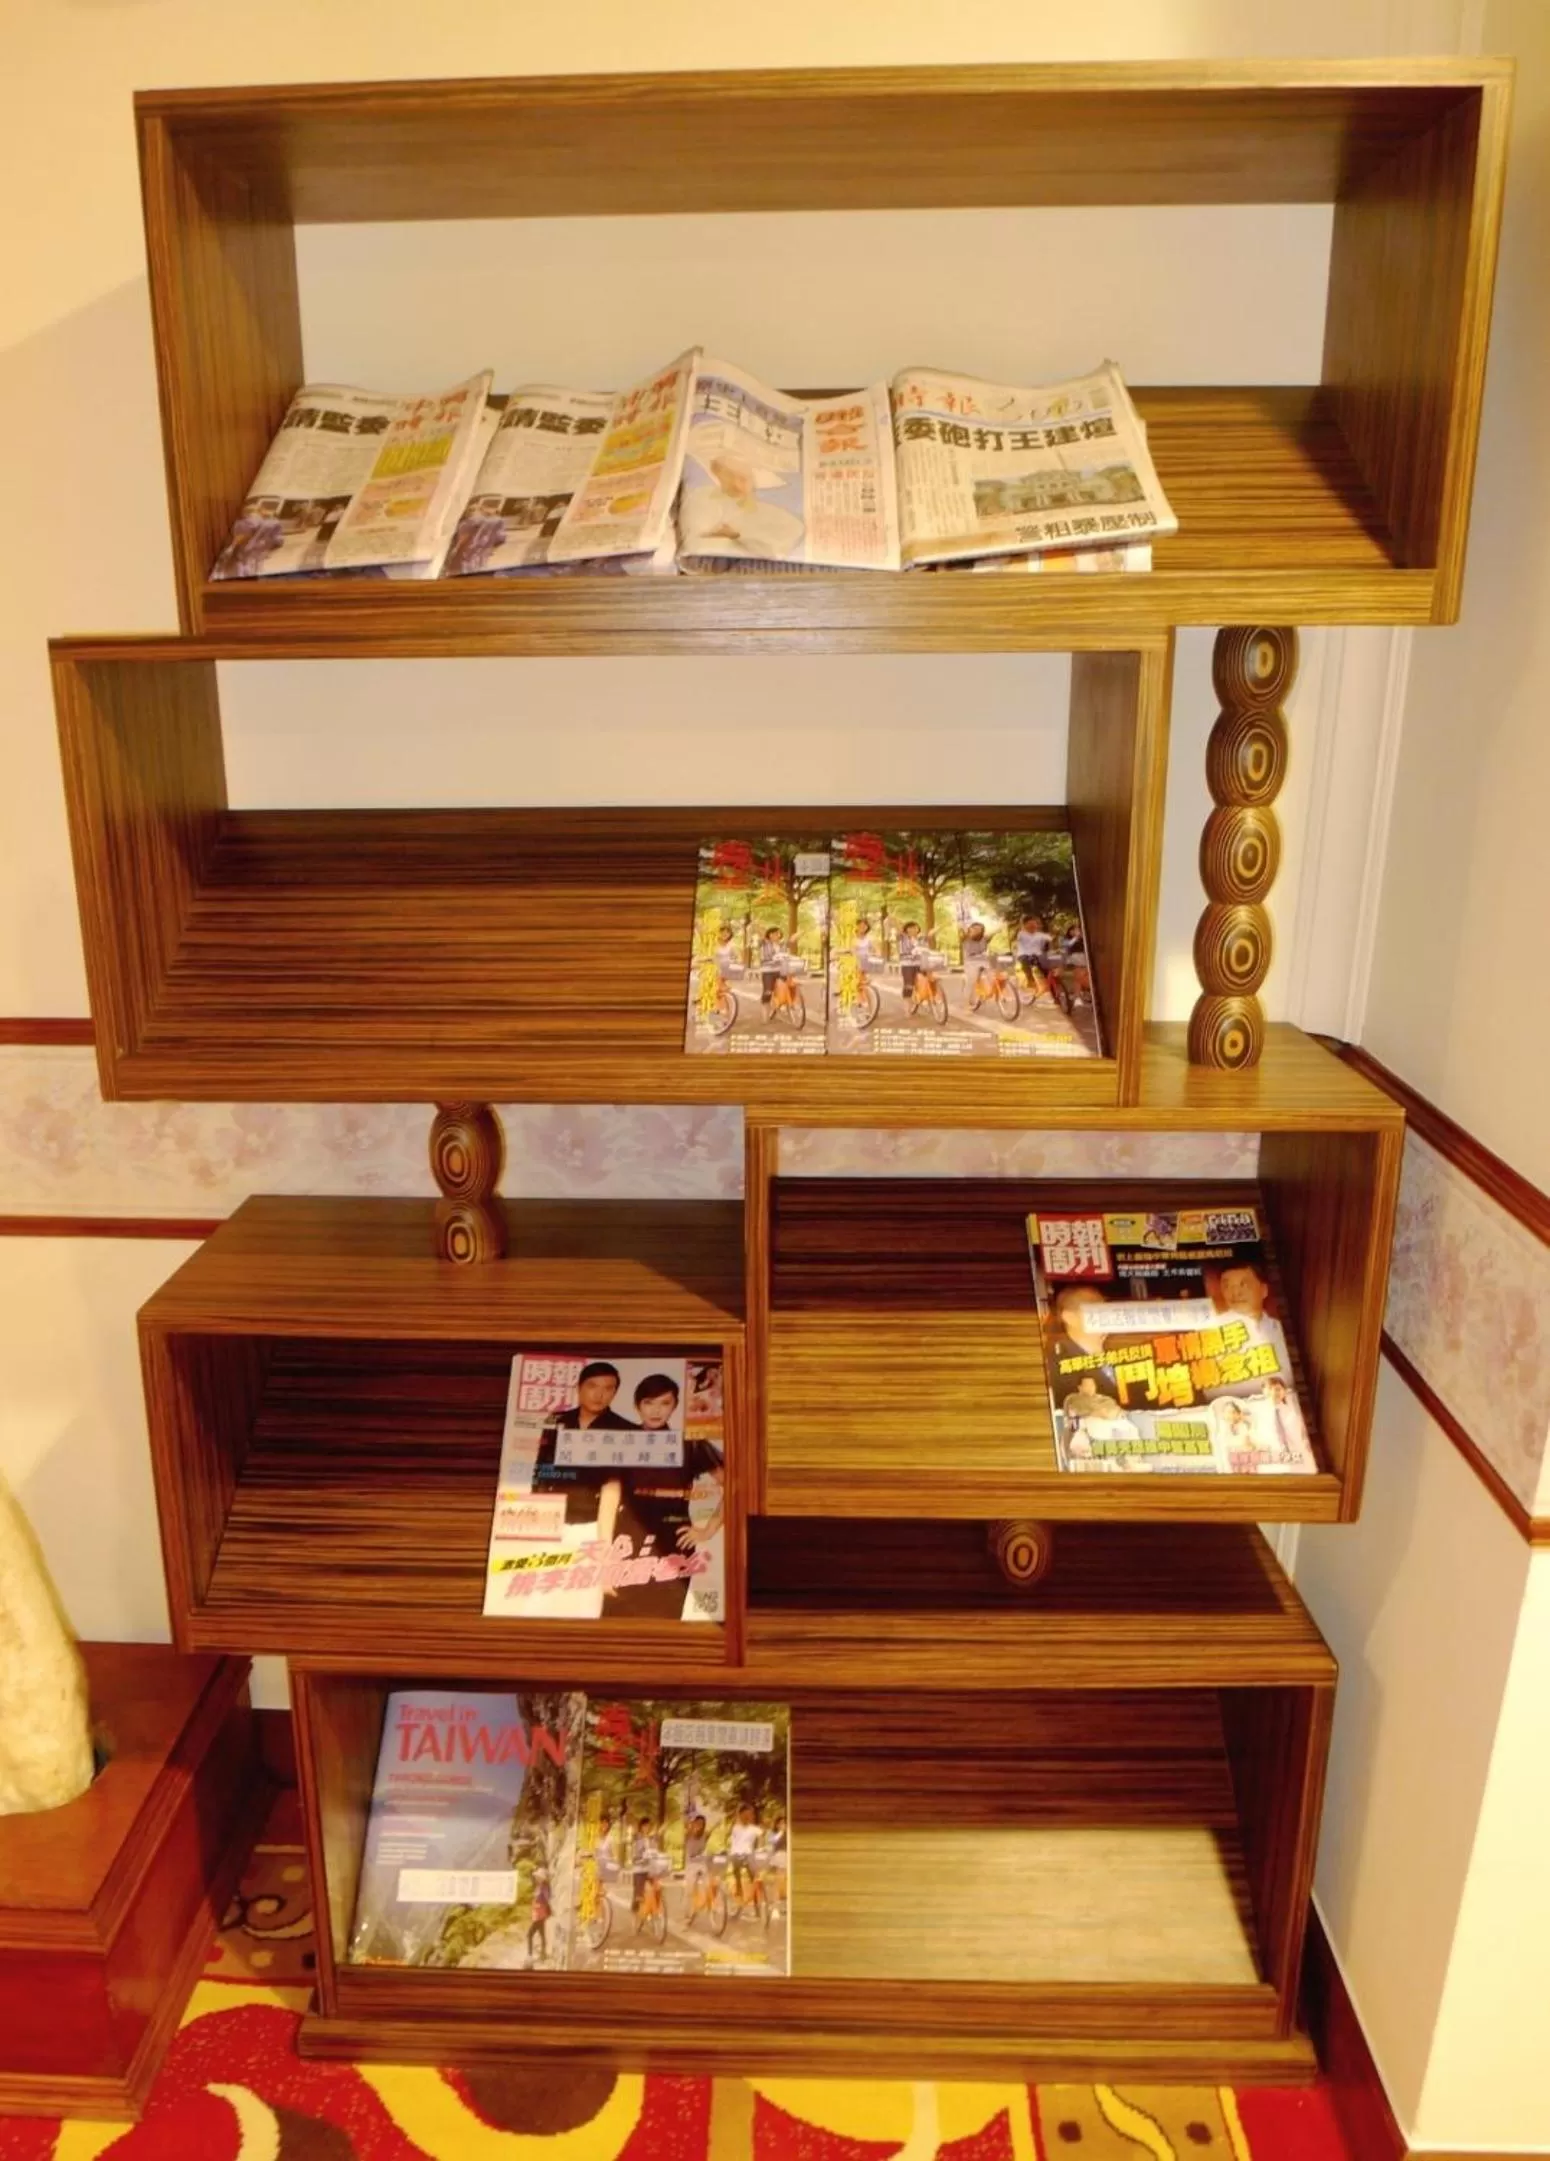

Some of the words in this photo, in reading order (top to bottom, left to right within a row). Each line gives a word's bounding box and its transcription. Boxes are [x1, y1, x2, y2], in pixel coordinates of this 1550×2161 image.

[895, 416, 1117, 452] 委砲打王建煊
[398, 1703, 455, 1721] Travel
[458, 1705, 478, 1721] in
[395, 1723, 569, 1767] TAIWAN
